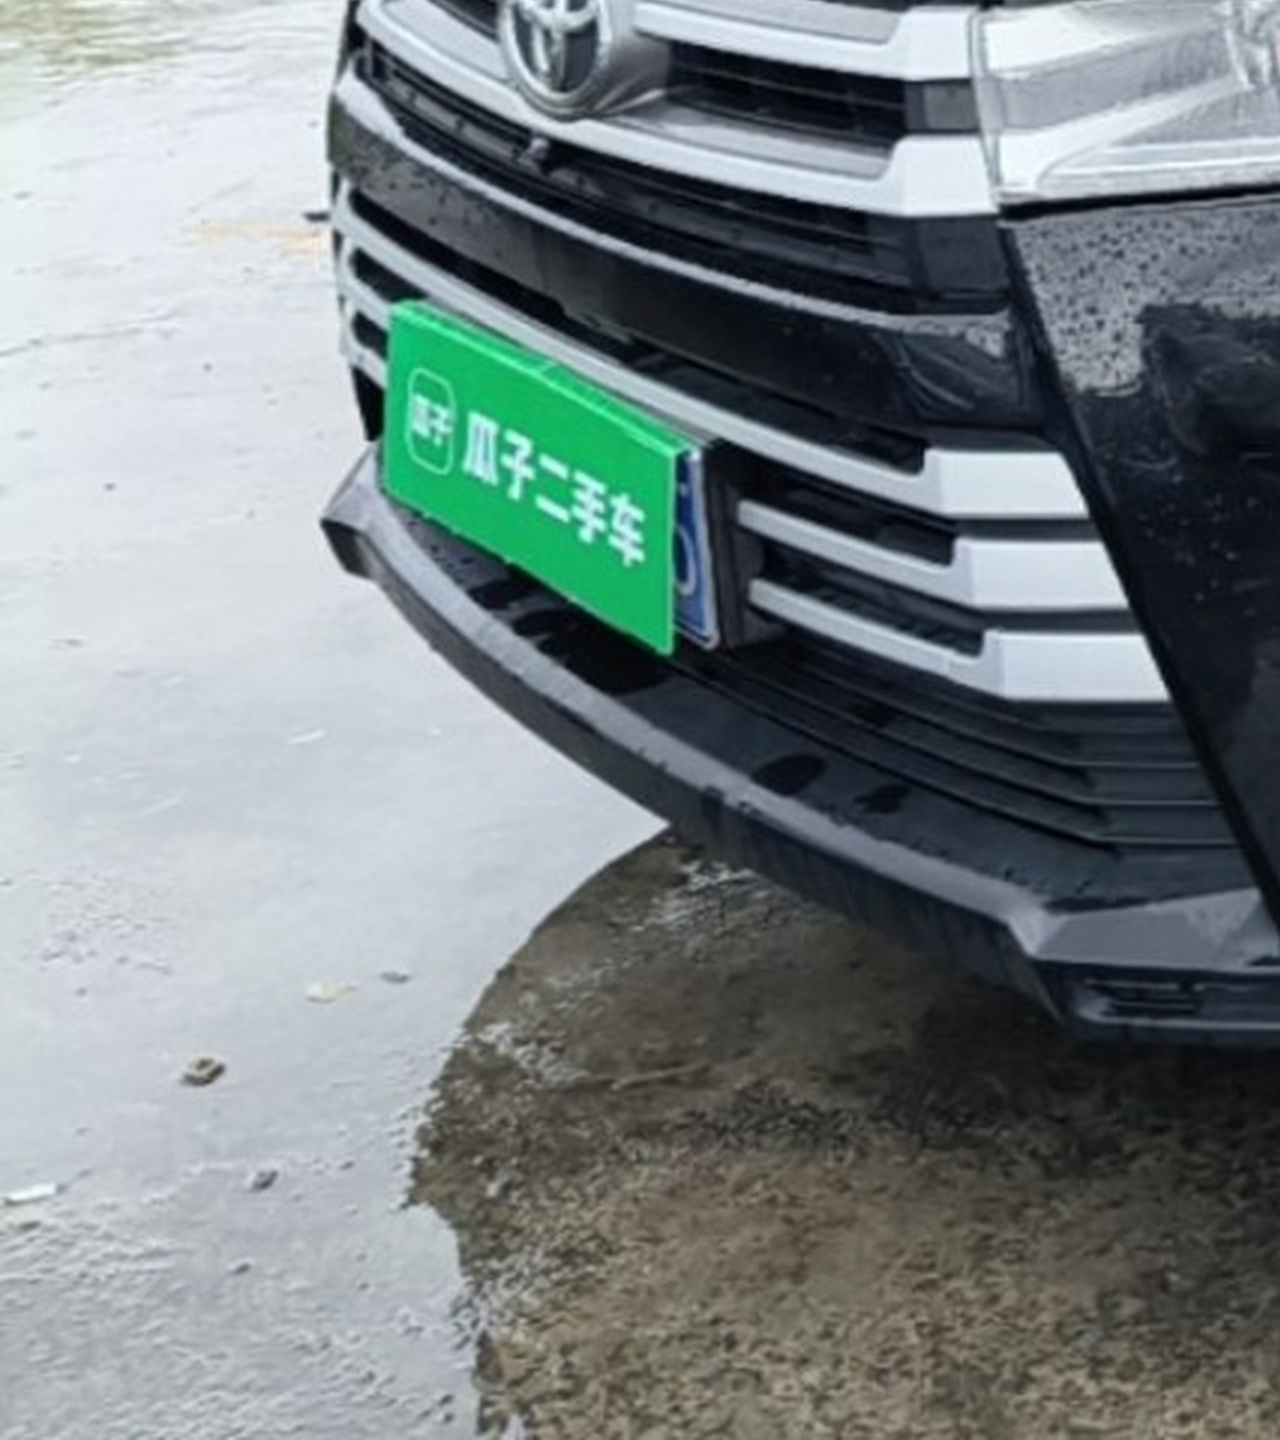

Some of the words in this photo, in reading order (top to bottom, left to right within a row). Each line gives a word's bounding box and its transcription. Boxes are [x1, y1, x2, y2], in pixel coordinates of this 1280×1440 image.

[462, 411, 646, 567] 瓜子二手车
